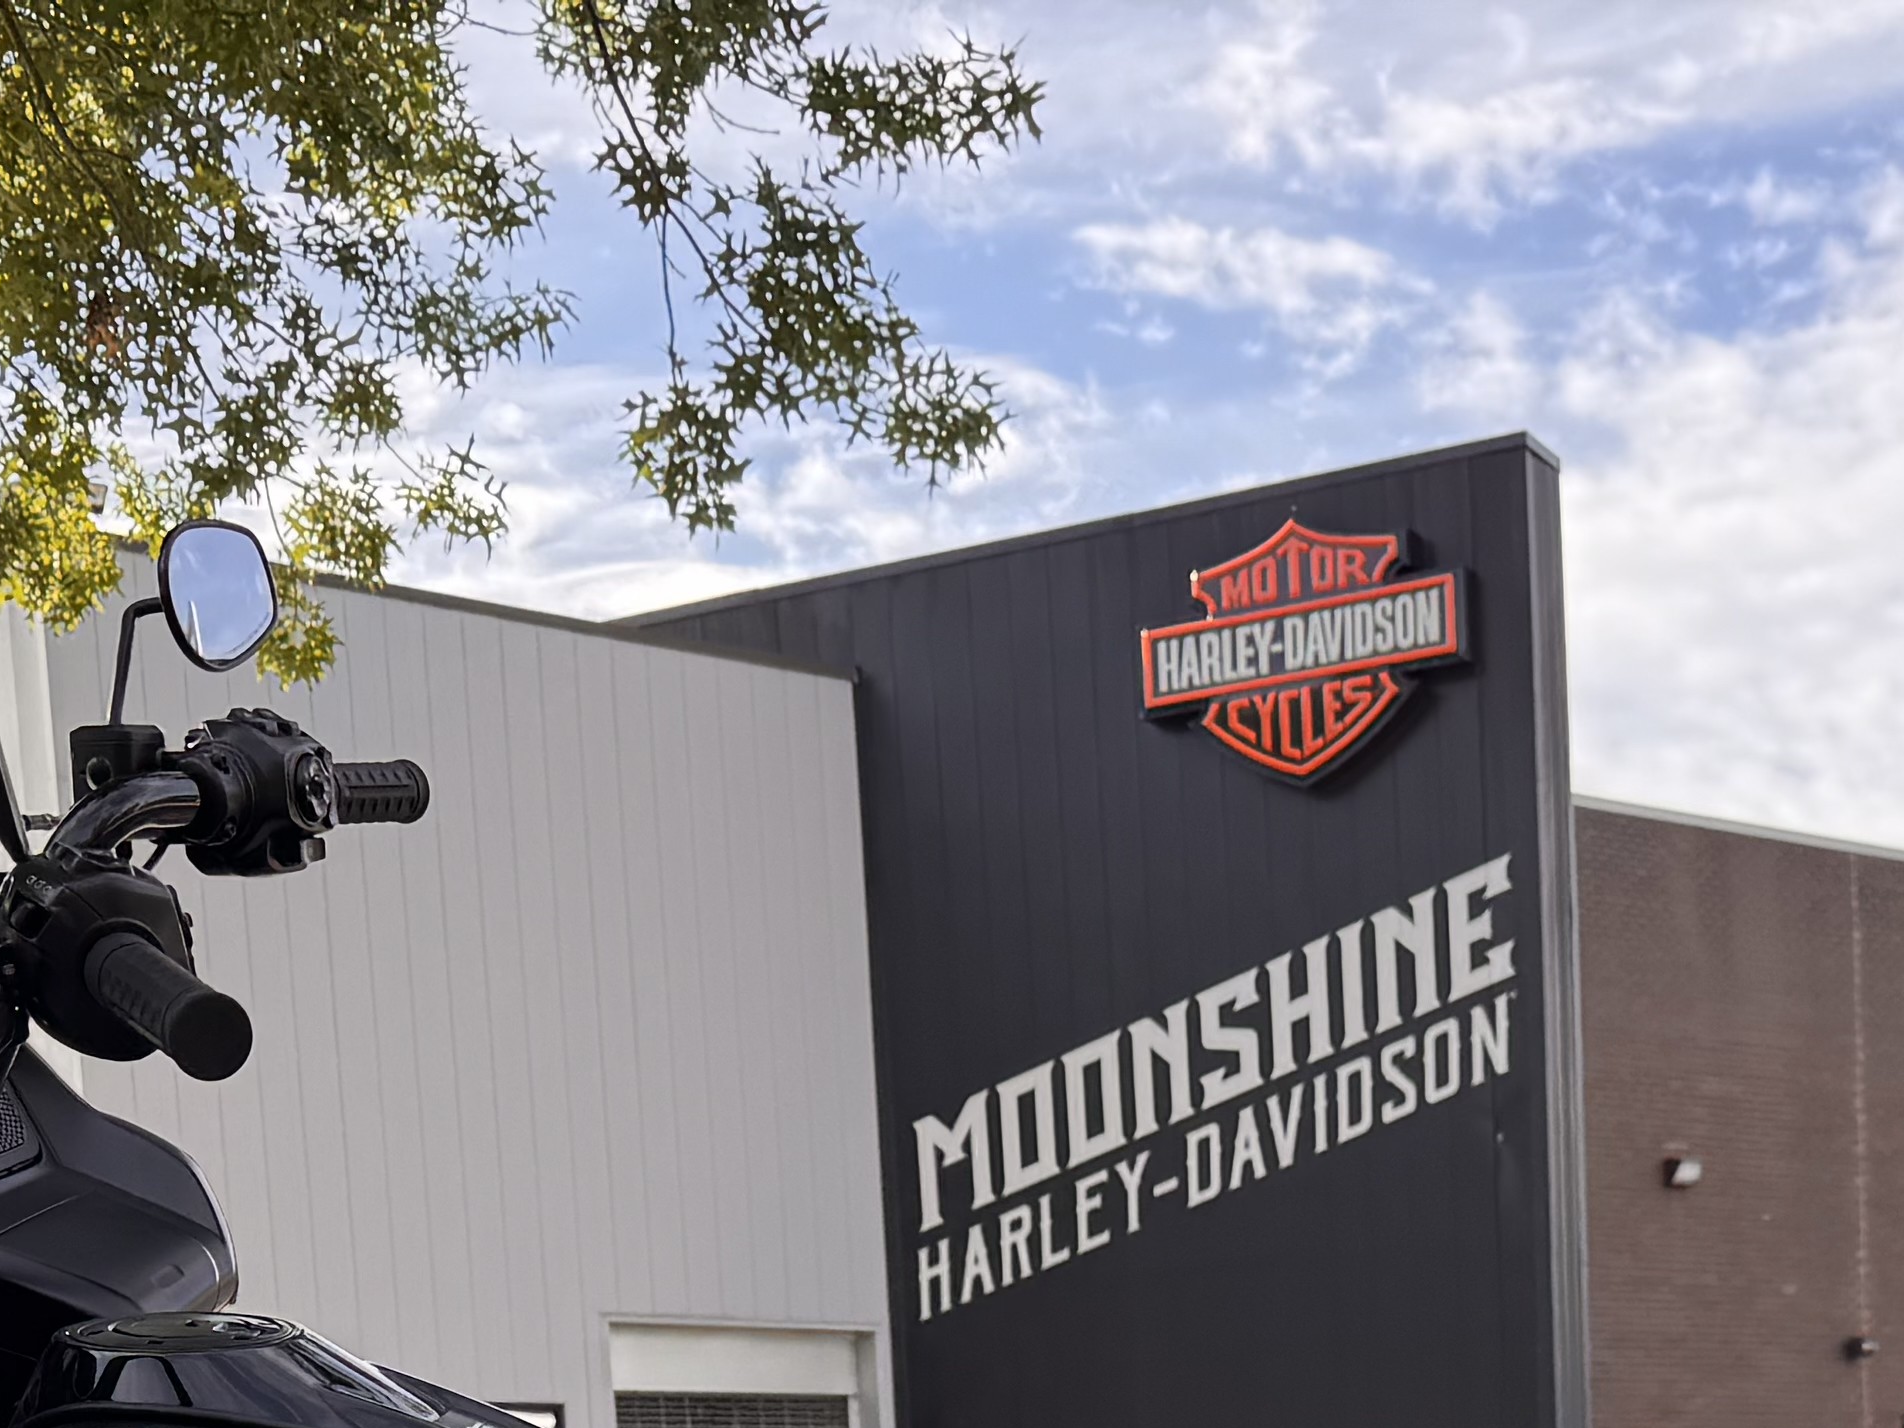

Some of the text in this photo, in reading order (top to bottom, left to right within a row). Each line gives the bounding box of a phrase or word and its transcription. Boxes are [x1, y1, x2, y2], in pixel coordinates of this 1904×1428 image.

[1220, 538, 1373, 610] MOTOR
[1157, 588, 1441, 693] HARLEY-DAVIDSON
[1225, 677, 1374, 760] CYCLES
[912, 853, 1517, 1233] MOONSHINE
[917, 994, 1512, 1322] HARLEY-DAVIDSON
